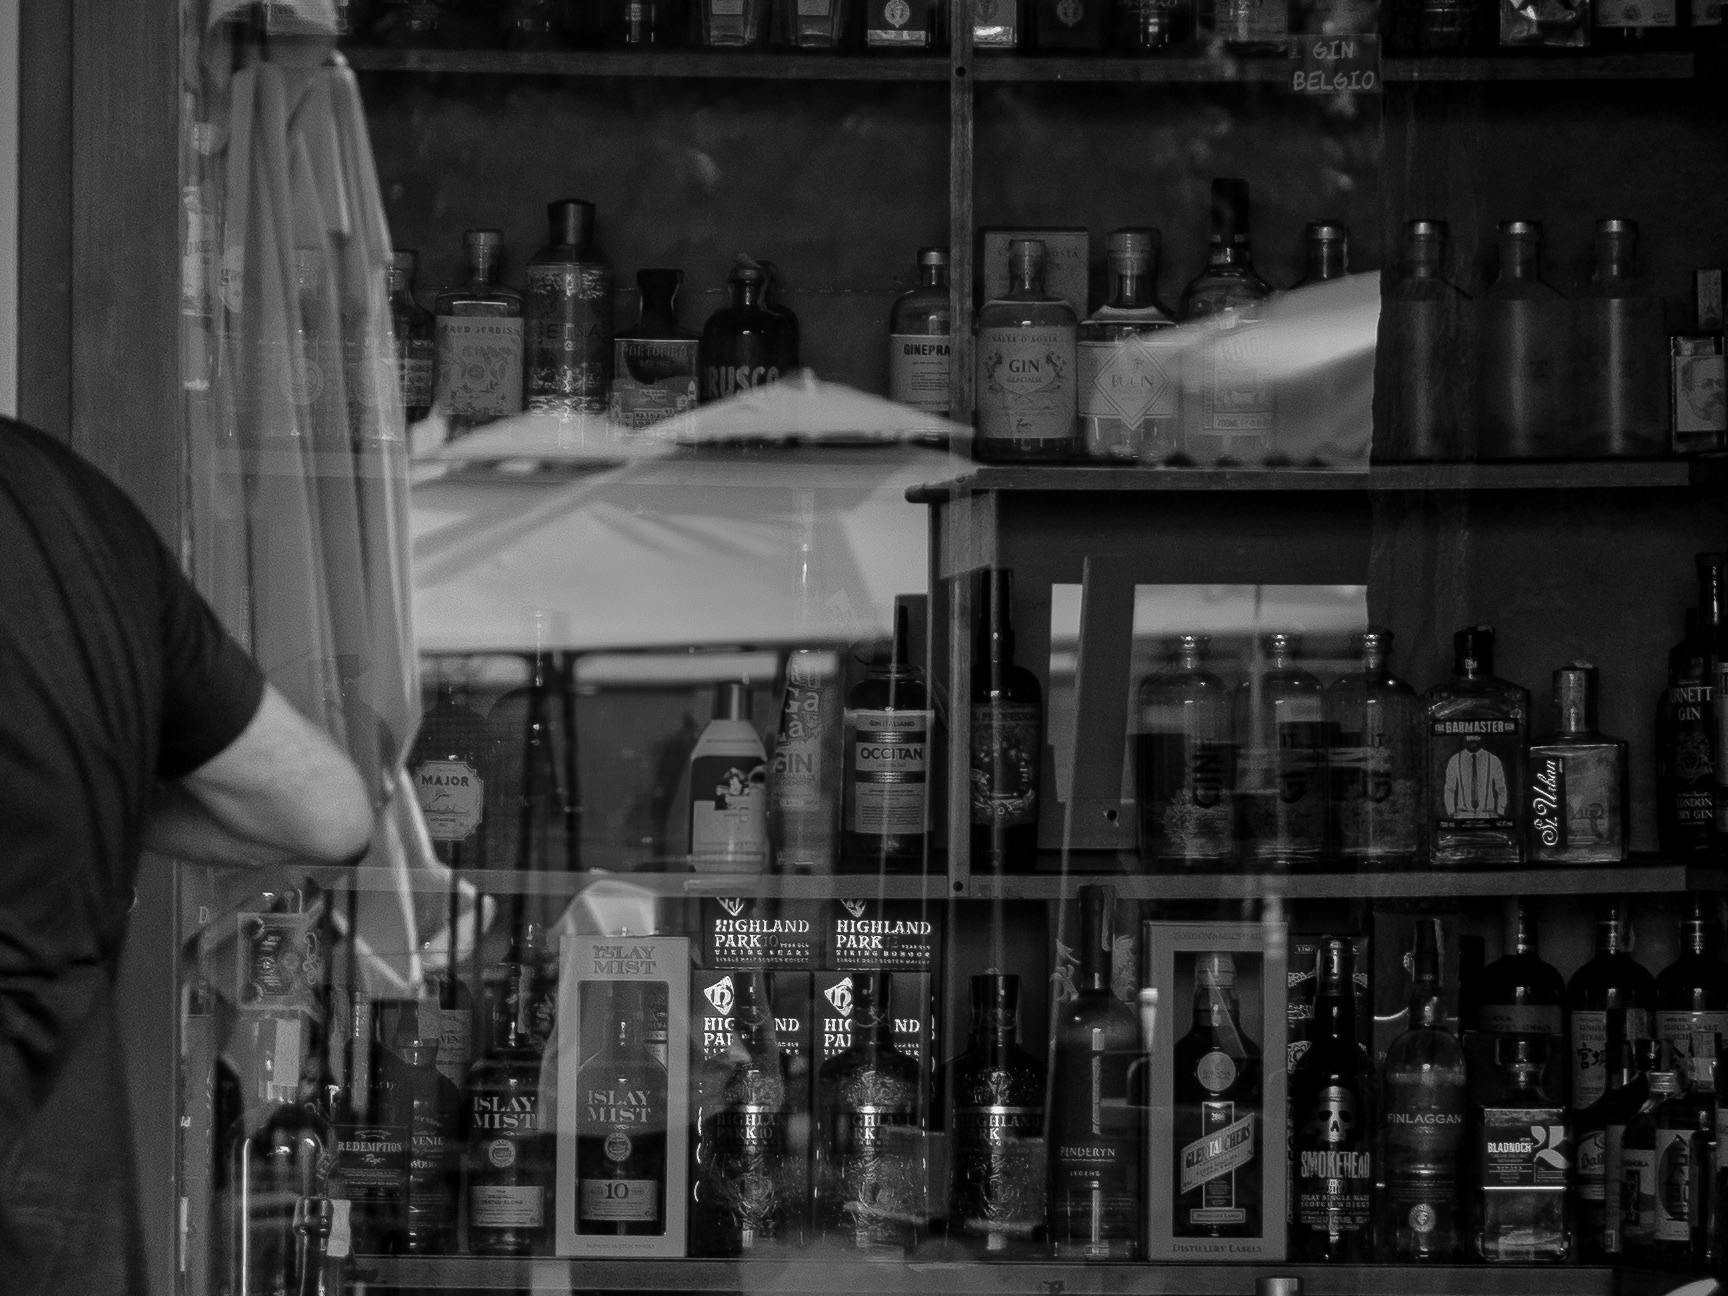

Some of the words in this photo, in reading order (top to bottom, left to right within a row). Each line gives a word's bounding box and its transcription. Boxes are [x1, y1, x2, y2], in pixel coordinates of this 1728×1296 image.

[1312, 41, 1354, 60] GIN
[1292, 70, 1375, 91] BELGIO
[1008, 359, 1040, 373] GIN
[1677, 706, 1701, 722] GIN
[1445, 720, 1504, 733] BARMASTER
[860, 747, 923, 761] OCCITAN
[775, 753, 813, 774] GIN
[422, 774, 470, 787] MAJOR
[714, 919, 809, 933] HIGHLAND
[835, 920, 931, 935] HIGHLAND
[714, 934, 761, 950] PARK
[835, 935, 882, 951] PARK
[592, 960, 657, 975] MIST
[473, 1096, 535, 1113] ISLAY
[587, 1090, 652, 1107] ISLAY
[473, 1113, 536, 1129] MIST
[587, 1108, 653, 1124] MIST
[1387, 1113, 1462, 1125] FINLAGGAN
[338, 1142, 402, 1155] REDEMPTION
[1060, 1145, 1116, 1158] PENDERYN
[1487, 1142, 1532, 1153] BLADNOCH
[1300, 1150, 1370, 1179] SMOKEHEAD
[604, 1182, 629, 1200] 10
[1172, 1243, 1225, 1253] DISTILLERY
[1227, 1244, 1262, 1253] LABELS
